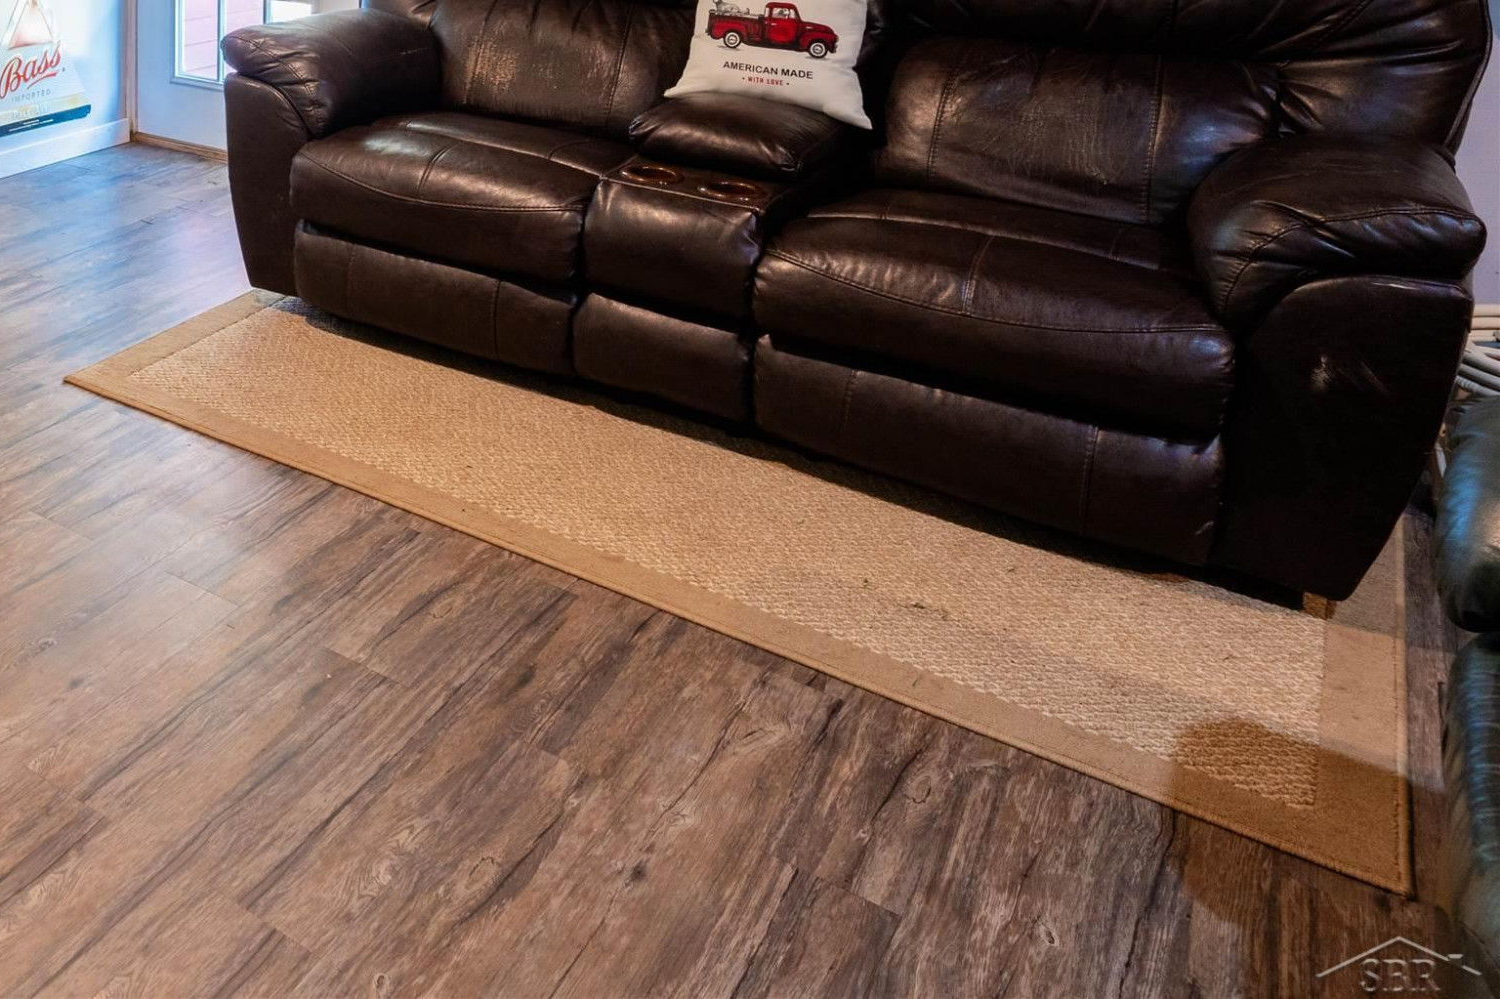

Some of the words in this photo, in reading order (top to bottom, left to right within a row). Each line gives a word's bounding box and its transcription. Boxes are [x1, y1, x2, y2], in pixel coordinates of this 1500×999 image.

[0, 40, 61, 99] Bass
[722, 61, 778, 76] AMERICAN
[781, 68, 813, 79] MADE
[748, 76, 764, 84] WITH
[767, 78, 783, 86] LOVE
[11, 88, 51, 102] IMPORTED
